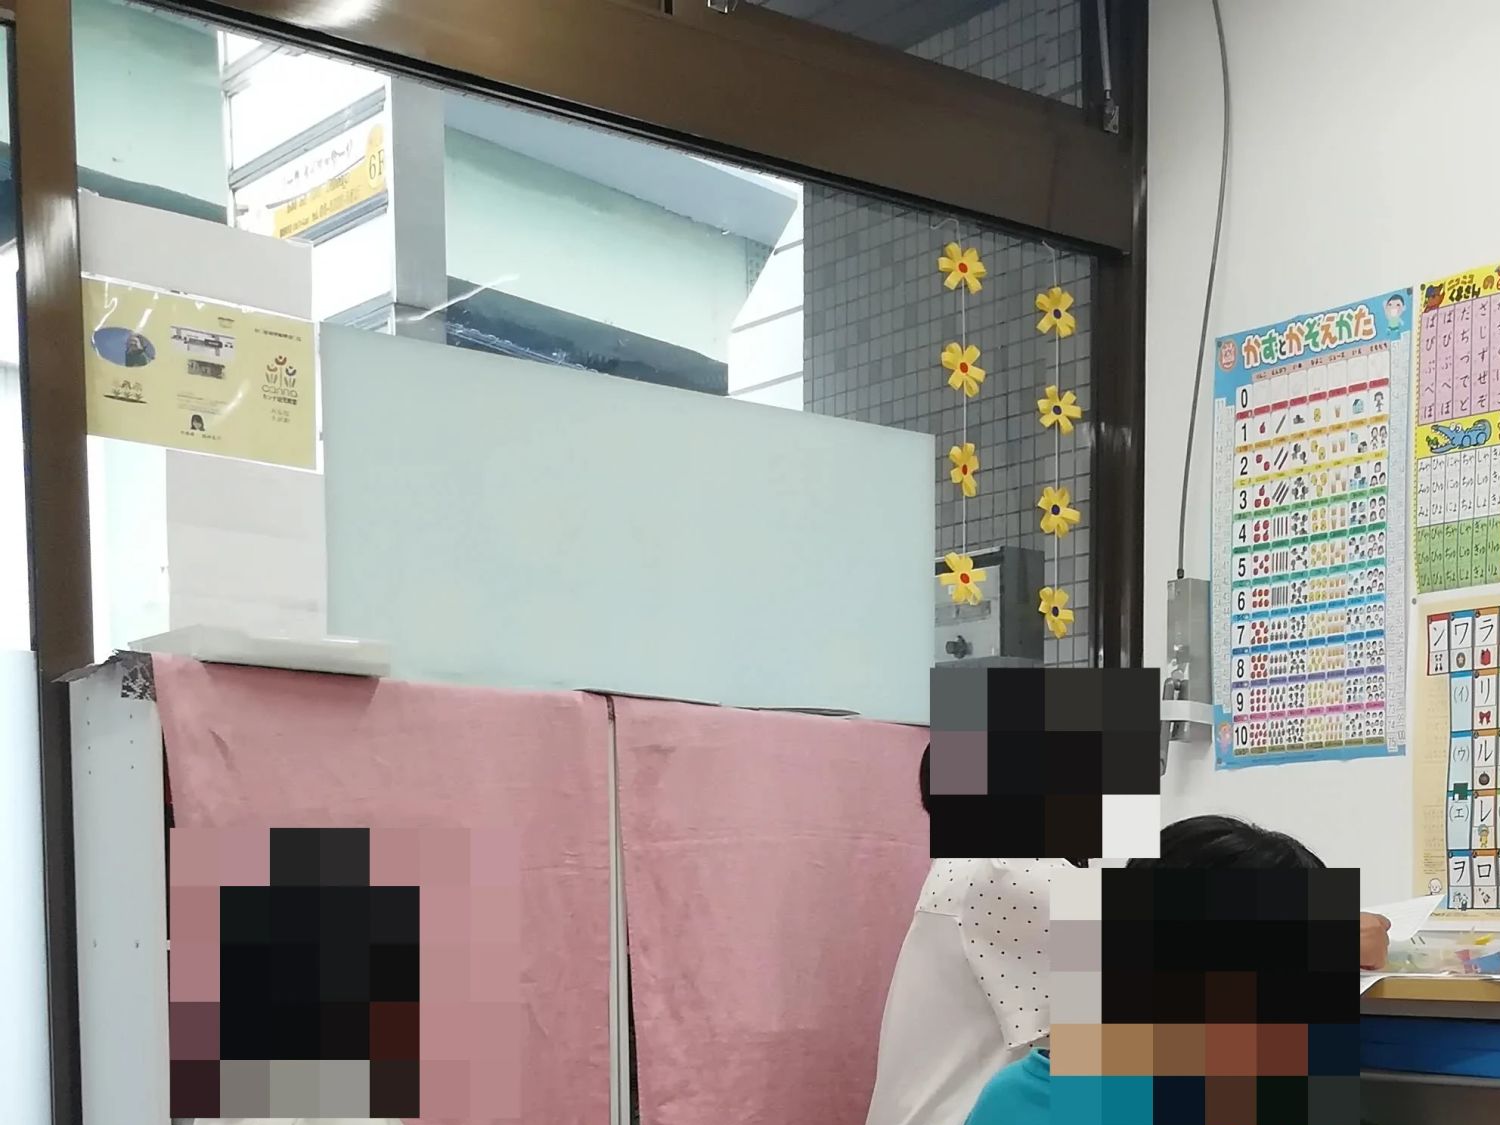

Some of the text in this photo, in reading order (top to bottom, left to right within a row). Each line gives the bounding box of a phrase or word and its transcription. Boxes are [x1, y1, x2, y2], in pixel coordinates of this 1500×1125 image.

[1244, 307, 1374, 367] かずとかぞえかた
[261, 384, 298, 398] canna
[1241, 388, 1248, 408] 0
[1242, 423, 1247, 439] 1
[1240, 456, 1248, 476] 2
[1239, 490, 1247, 510] 3
[1239, 524, 1246, 543] 4
[1238, 558, 1246, 577] 5
[1238, 591, 1245, 611] 6
[1237, 625, 1245, 644] 7
[1433, 627, 1444, 646] ン
[1454, 622, 1469, 645] ワ
[1237, 659, 1244, 678] 8
[1236, 692, 1243, 712] 9
[1235, 725, 1248, 746] 10
[1477, 618, 1494, 878] ラ リ ル レ ロ
[1453, 861, 1466, 882] ヲ
